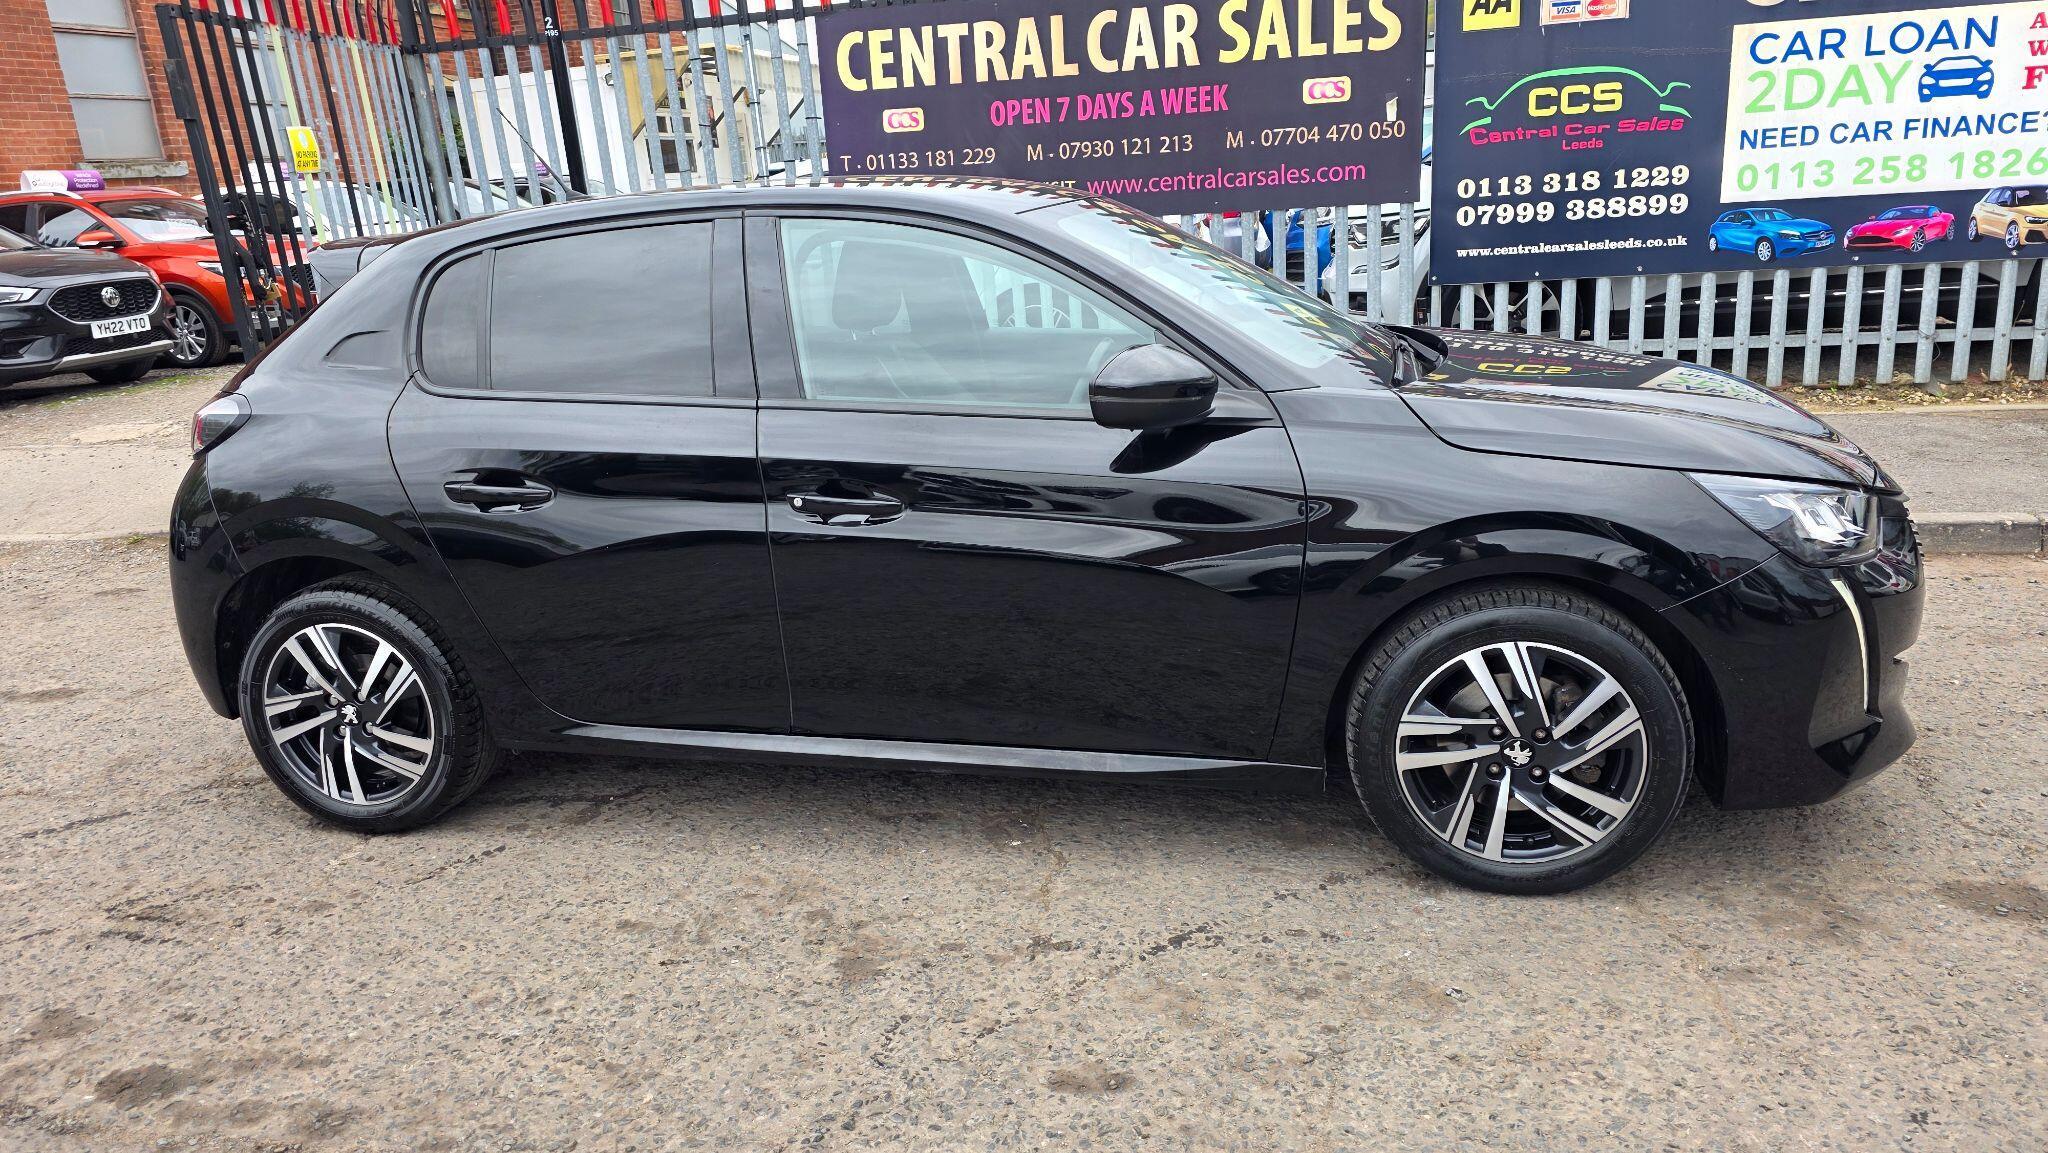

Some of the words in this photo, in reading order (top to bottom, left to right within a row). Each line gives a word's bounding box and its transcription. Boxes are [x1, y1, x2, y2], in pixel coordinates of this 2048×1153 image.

[545, 17, 553, 29] 2
[1557, 6, 1576, 14] VISA
[837, 15, 1079, 92] CENTRAL
[1087, 3, 1200, 73] CAR
[1218, 0, 1402, 63] SALES
[1750, 28, 1847, 64] CAR
[1865, 16, 1999, 56] LOAN
[1308, 81, 1345, 99] CCS
[1528, 81, 1623, 117] CCS
[1745, 60, 1913, 114] 2DAY
[990, 98, 1050, 127] OPEN
[1057, 97, 1070, 123] 7
[1077, 91, 1133, 121] DAYS
[1139, 91, 1156, 117] A
[1161, 84, 1229, 115] WEEK
[1261, 125, 1320, 147] 07704
[1326, 123, 1363, 142] 470
[1369, 120, 1406, 139] 050
[1470, 125, 1557, 145] Central
[1565, 124, 1611, 136] Car
[1618, 117, 1684, 133] Sales
[1562, 138, 1604, 150] Leeds
[1740, 125, 1819, 150] NEED
[1830, 121, 1893, 144] CAR
[866, 152, 919, 171] 01133
[926, 150, 954, 167] 181
[963, 148, 996, 166] 229
[1059, 140, 1114, 159] 07930
[1121, 137, 1150, 156] 121
[1159, 134, 1193, 154] 213
[1087, 162, 1366, 195] www.centralcarsales.com
[1457, 175, 1532, 199] 0113
[1542, 171, 1600, 193] 318
[1614, 165, 1690, 189] 1229
[1737, 160, 1835, 192] 0113
[1853, 154, 1927, 185] 258
[1949, 147, 2048, 180] 1826
[1456, 201, 1555, 226] 07999
[1566, 193, 1689, 221] 388899
[1457, 235, 1687, 258] www.centralcarsalesleeds.co.uk
[97, 321, 124, 335] YH22
